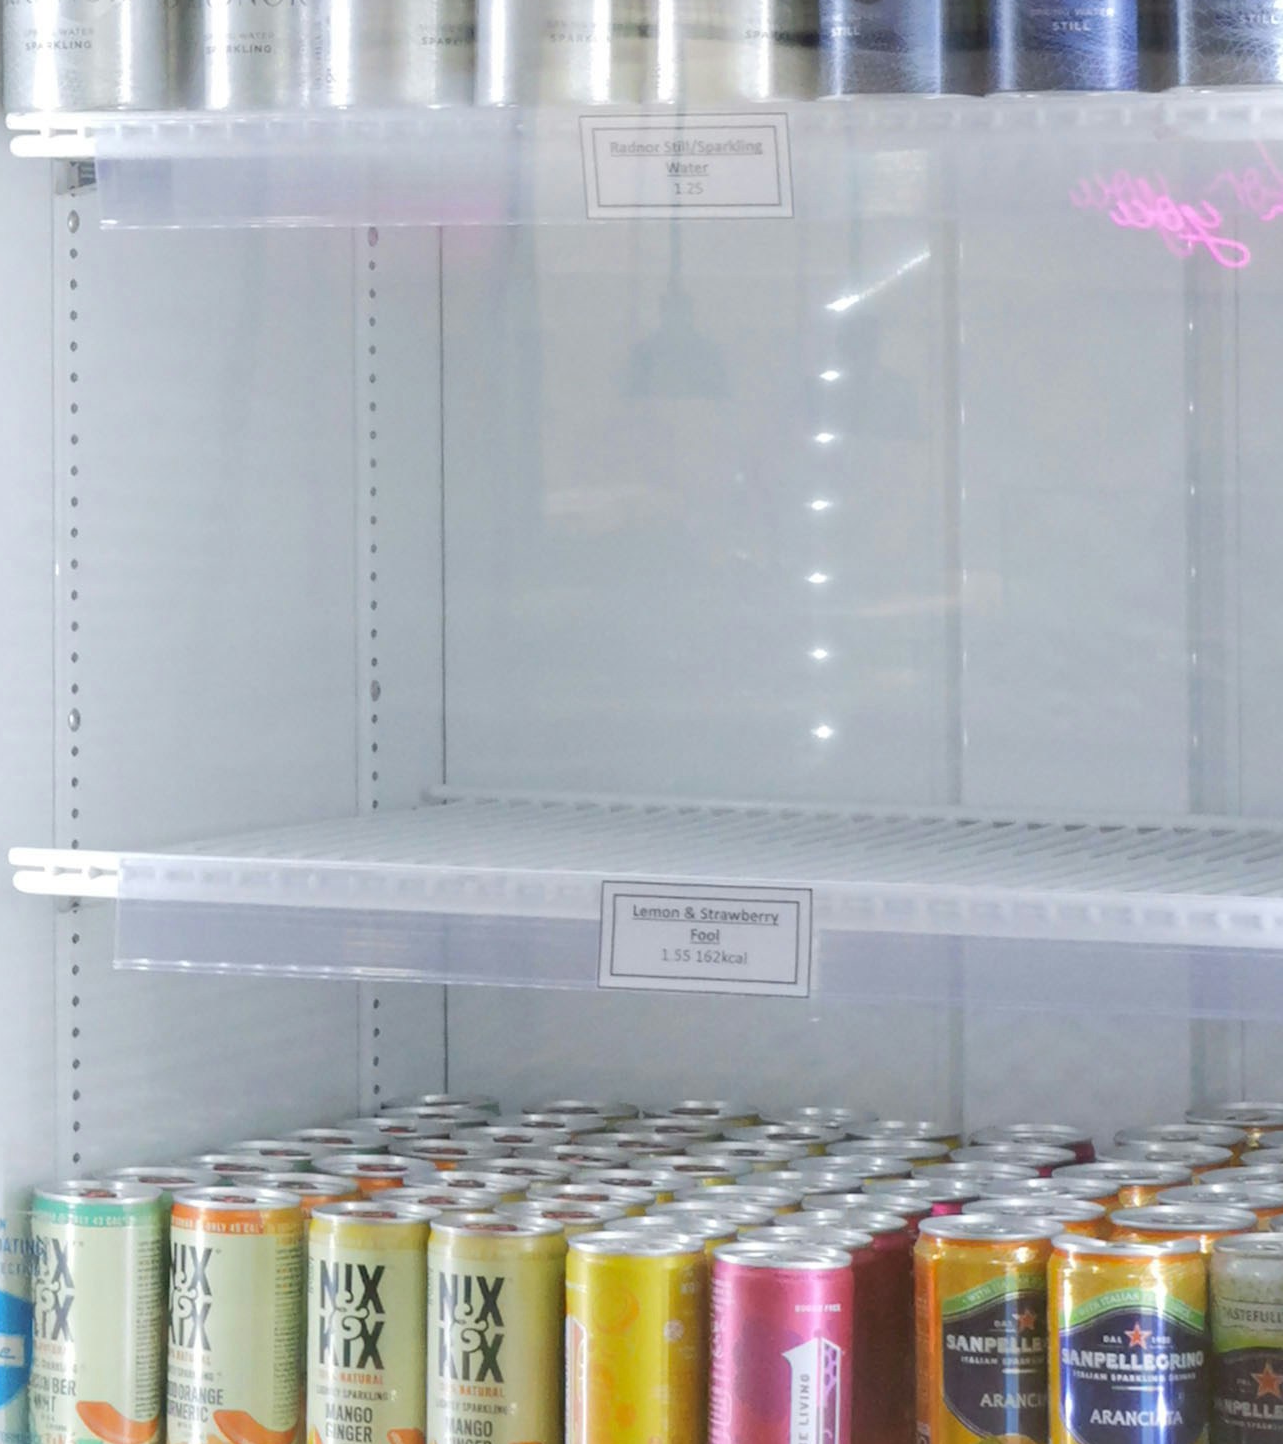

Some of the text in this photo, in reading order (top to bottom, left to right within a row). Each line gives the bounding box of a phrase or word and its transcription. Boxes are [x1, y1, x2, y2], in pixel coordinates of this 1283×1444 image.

[610, 140, 660, 155] Radnor
[666, 160, 709, 174] Water
[633, 904, 779, 926] Lemon & Strawberry
[690, 928, 720, 943] Fool
[696, 949, 748, 965] 162kcal
[320, 1260, 385, 1314] NIX
[319, 1316, 385, 1370] KIX
[799, 1372, 810, 1427] LIVING
[326, 1403, 373, 1423] MANGO
